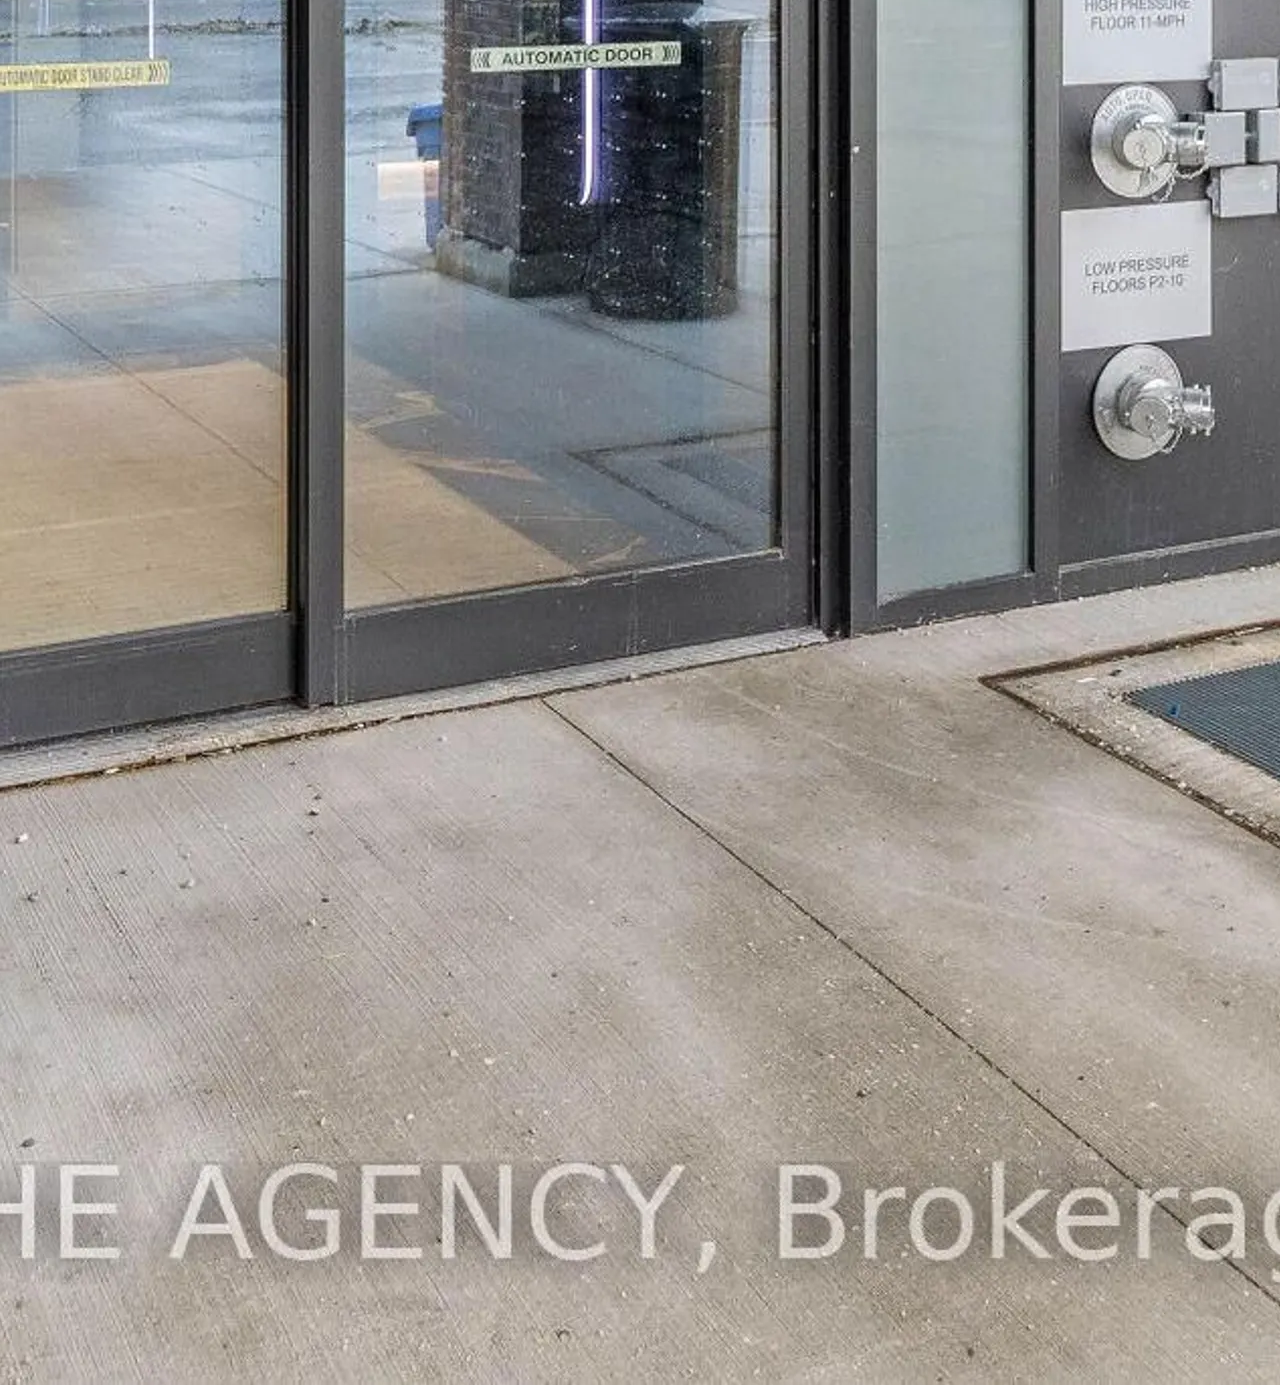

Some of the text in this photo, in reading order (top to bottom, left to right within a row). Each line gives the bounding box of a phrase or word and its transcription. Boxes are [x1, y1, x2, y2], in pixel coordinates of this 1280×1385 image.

[1090, 14, 1186, 31] FLOOR 11-MPH
[502, 47, 653, 66] AUTOMATIC DOOR
[51, 67, 78, 85] DOOR
[112, 65, 143, 82] CLEAR
[1084, 254, 1189, 277] LOW PRESSURE
[1092, 273, 1184, 295] FLOORS P2-10
